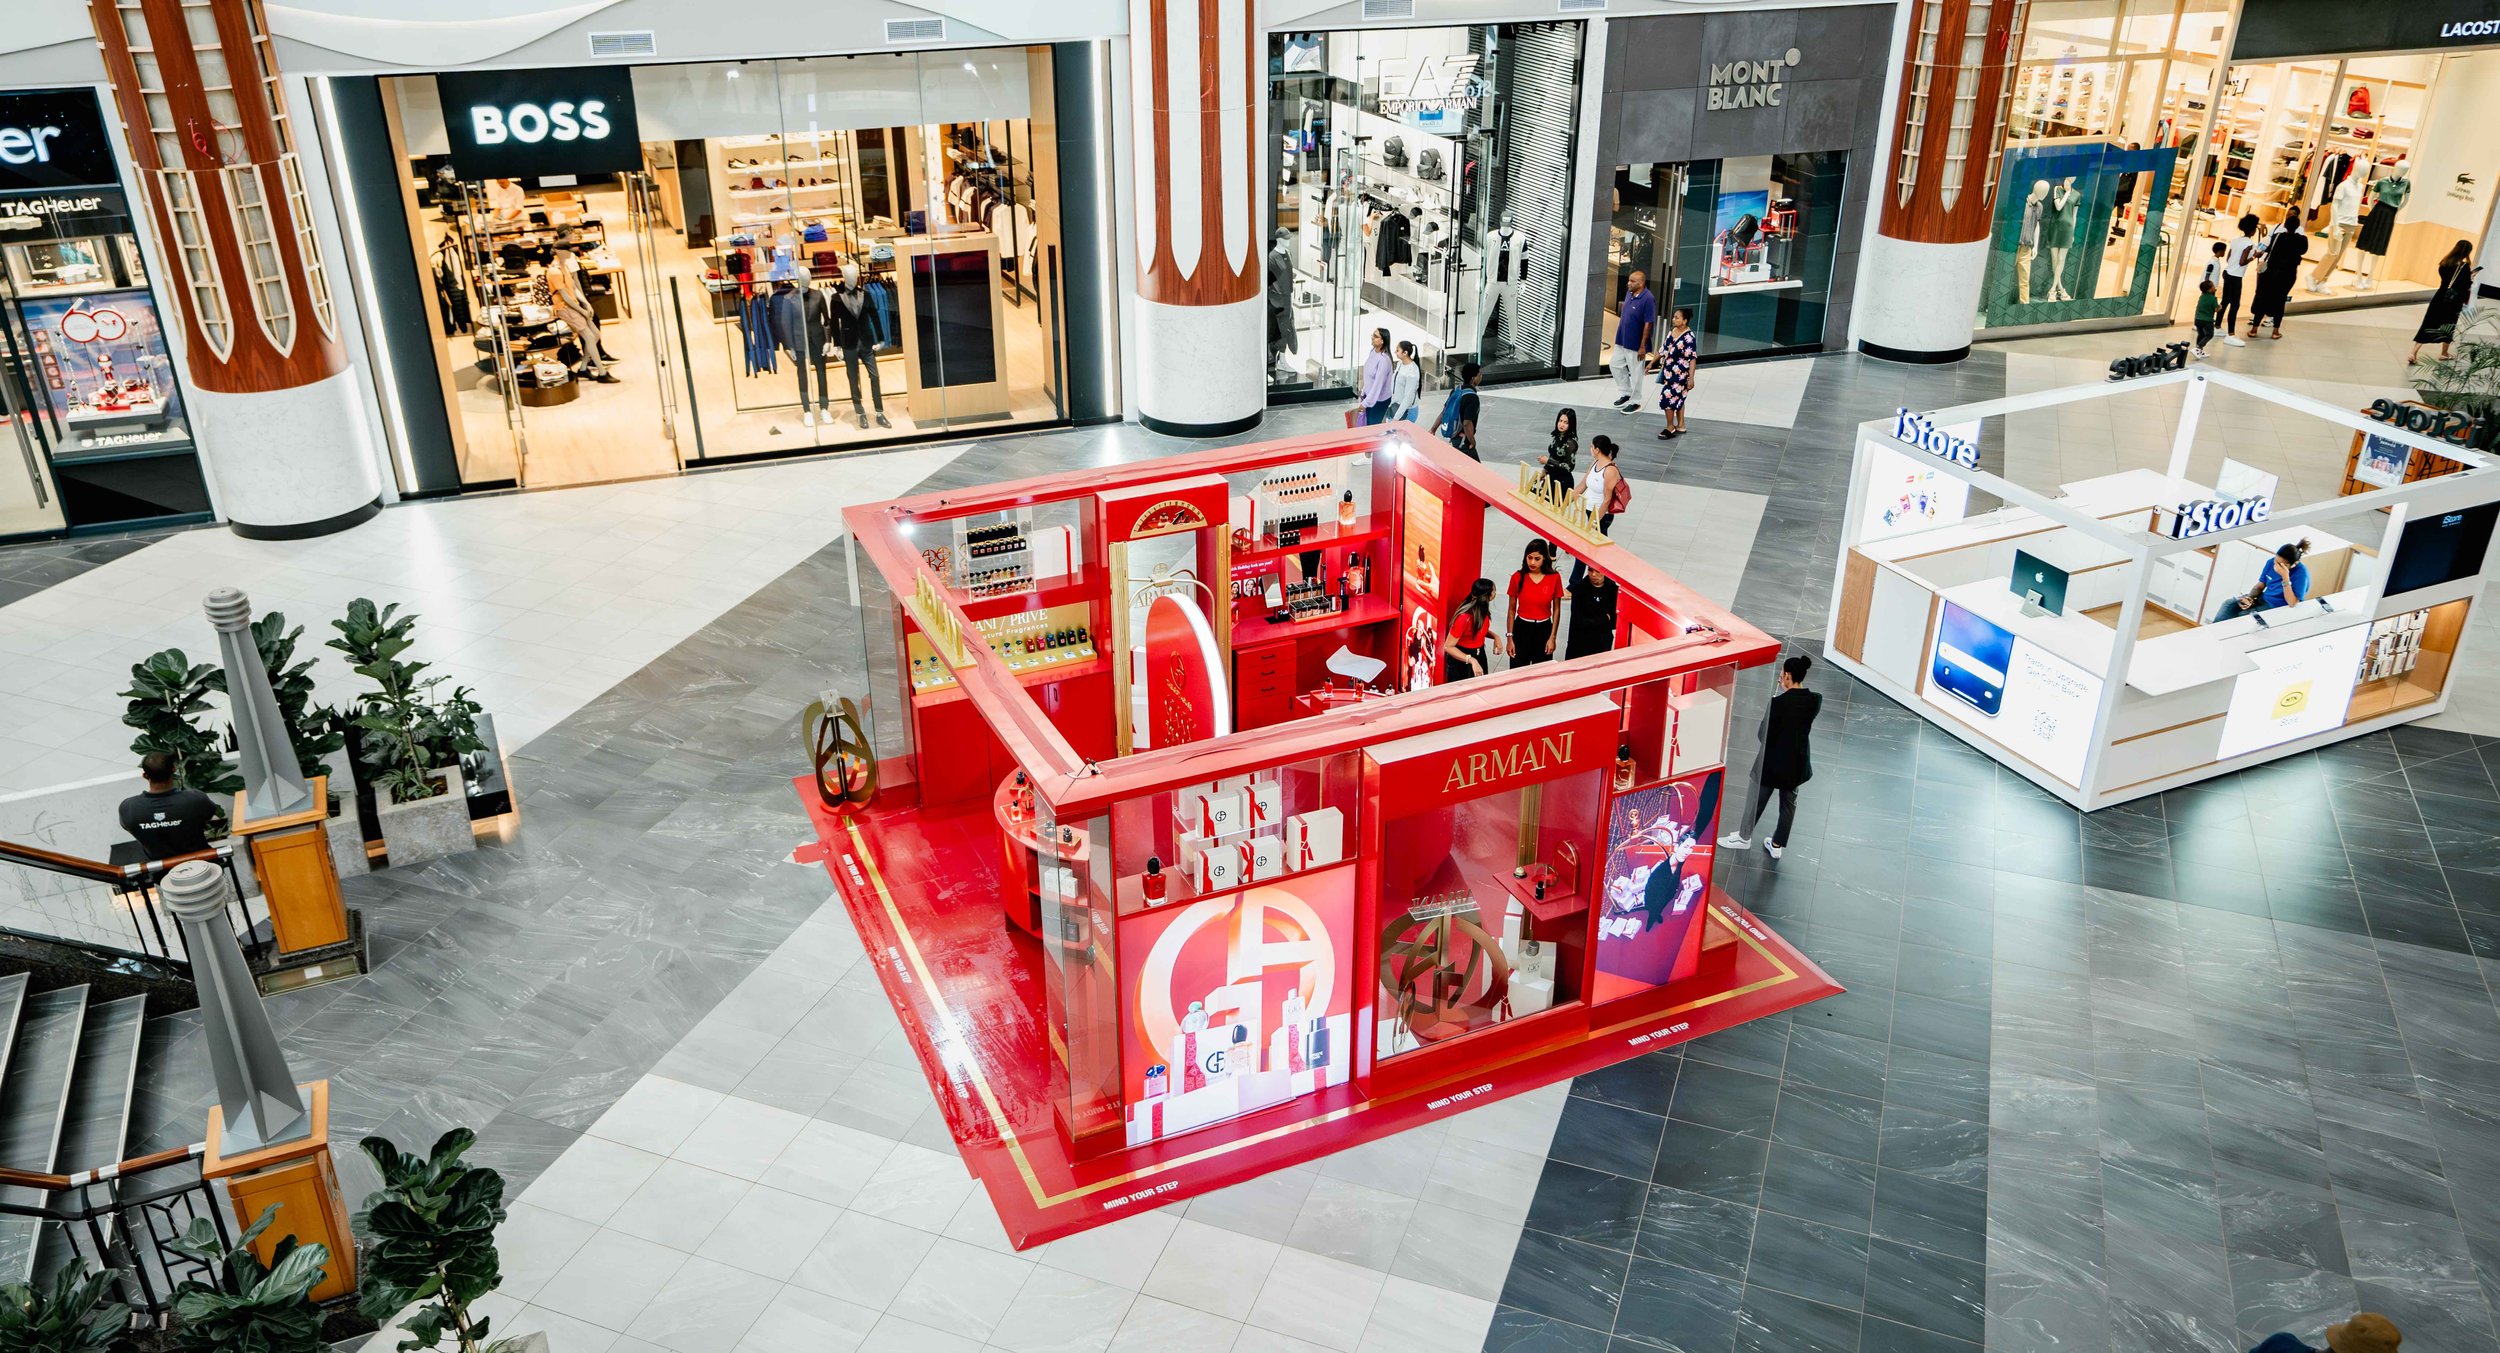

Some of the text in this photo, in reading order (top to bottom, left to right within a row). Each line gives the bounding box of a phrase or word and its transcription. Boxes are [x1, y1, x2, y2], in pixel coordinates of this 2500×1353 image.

[1710, 60, 1785, 86] MONT
[1380, 97, 1478, 115] EMPORIO ARMANI
[1707, 83, 1783, 110] BLANC
[471, 100, 611, 145] BOSS
[0, 126, 62, 165] er
[1892, 406, 1980, 469] iStore
[2172, 494, 2272, 540] iStore
[1006, 623, 1049, 635] Fragrances
[1442, 731, 1575, 793] ARMANI
[1628, 1021, 1690, 1046] MIND YOUR STEP
[1426, 1083, 1493, 1111] MIND YOUR STEP
[1102, 1180, 1179, 1210] MIND YOUR STEP
